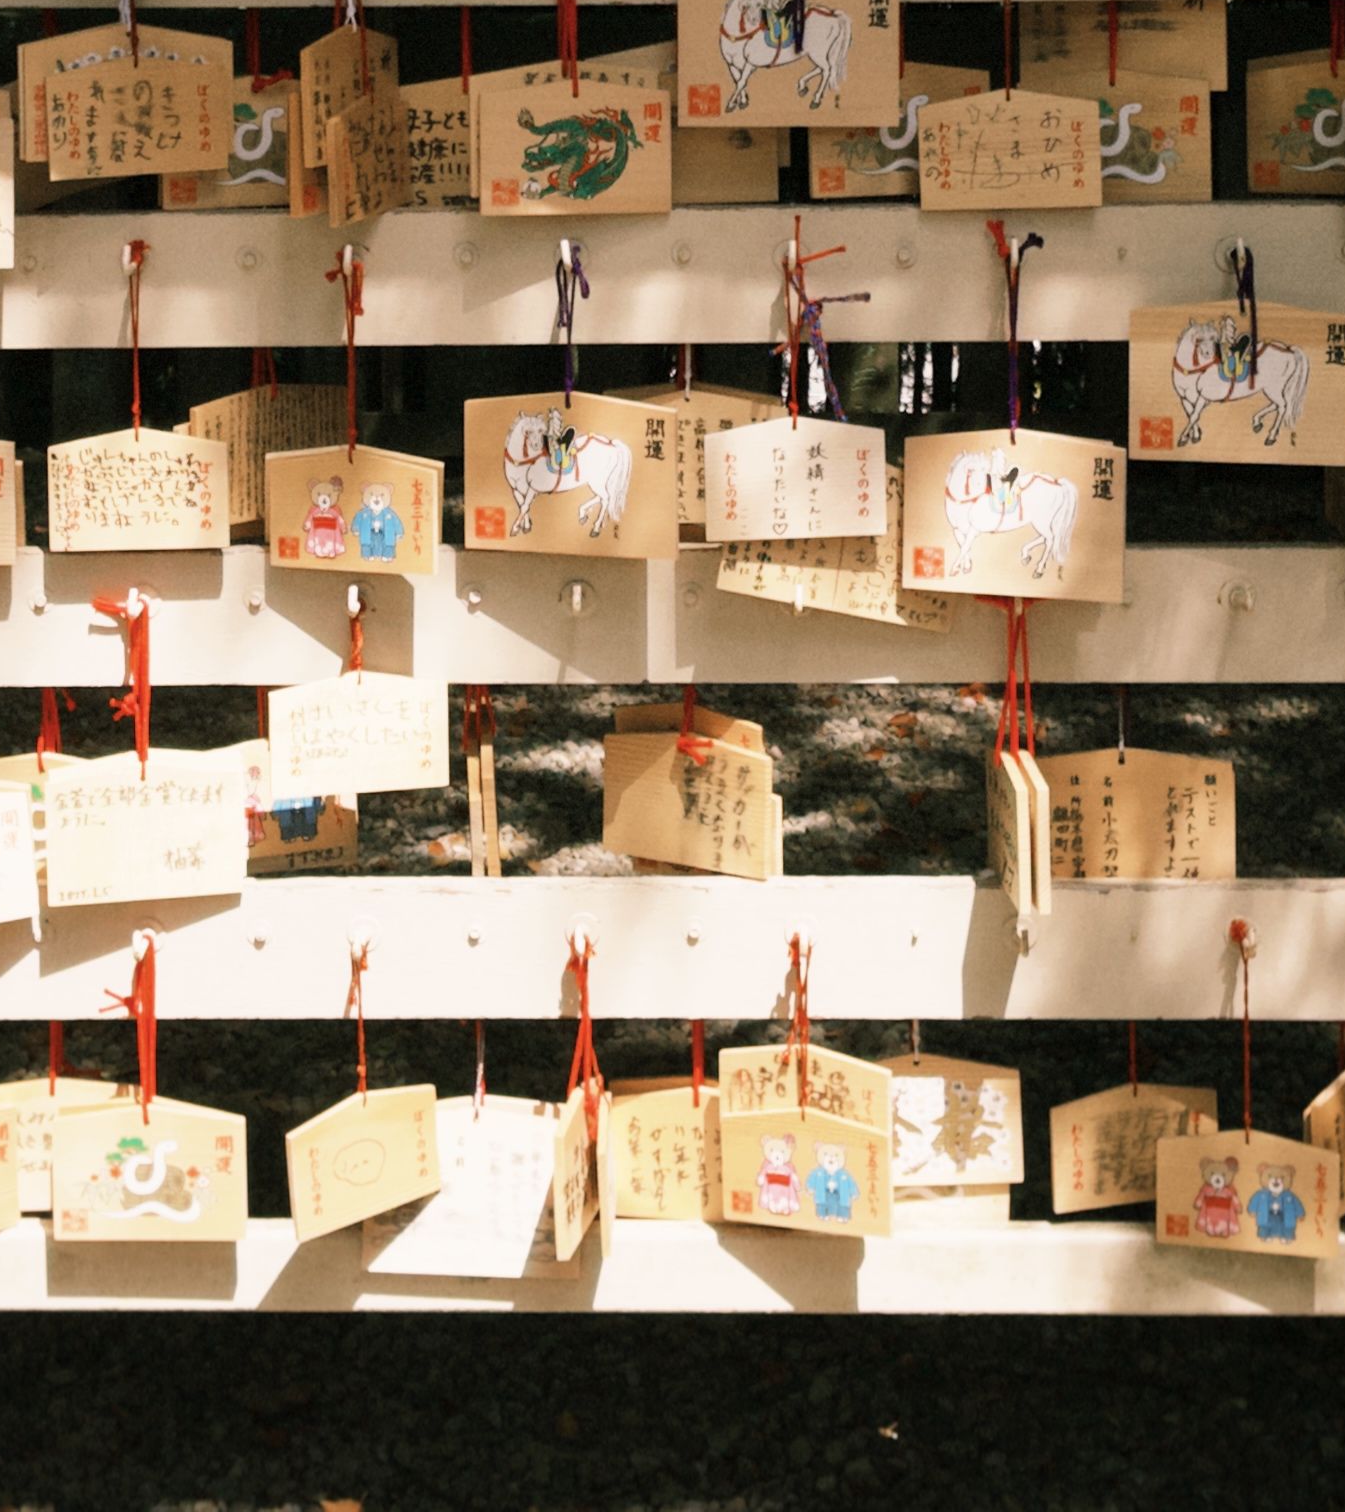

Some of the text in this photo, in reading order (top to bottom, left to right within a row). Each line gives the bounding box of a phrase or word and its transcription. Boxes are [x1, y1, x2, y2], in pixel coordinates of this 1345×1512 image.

[66, 92, 80, 159] わたしのゆめ
[196, 85, 212, 152] ぼくのゆめ
[645, 418, 665, 461] 開運
[724, 452, 738, 521] わたしのゆめ
[856, 449, 870, 518] ぼくのゆめ
[1092, 457, 1114, 500] 開運
[1204, 774, 1217, 828] 願いごと
[214, 1135, 234, 1175] 開運
